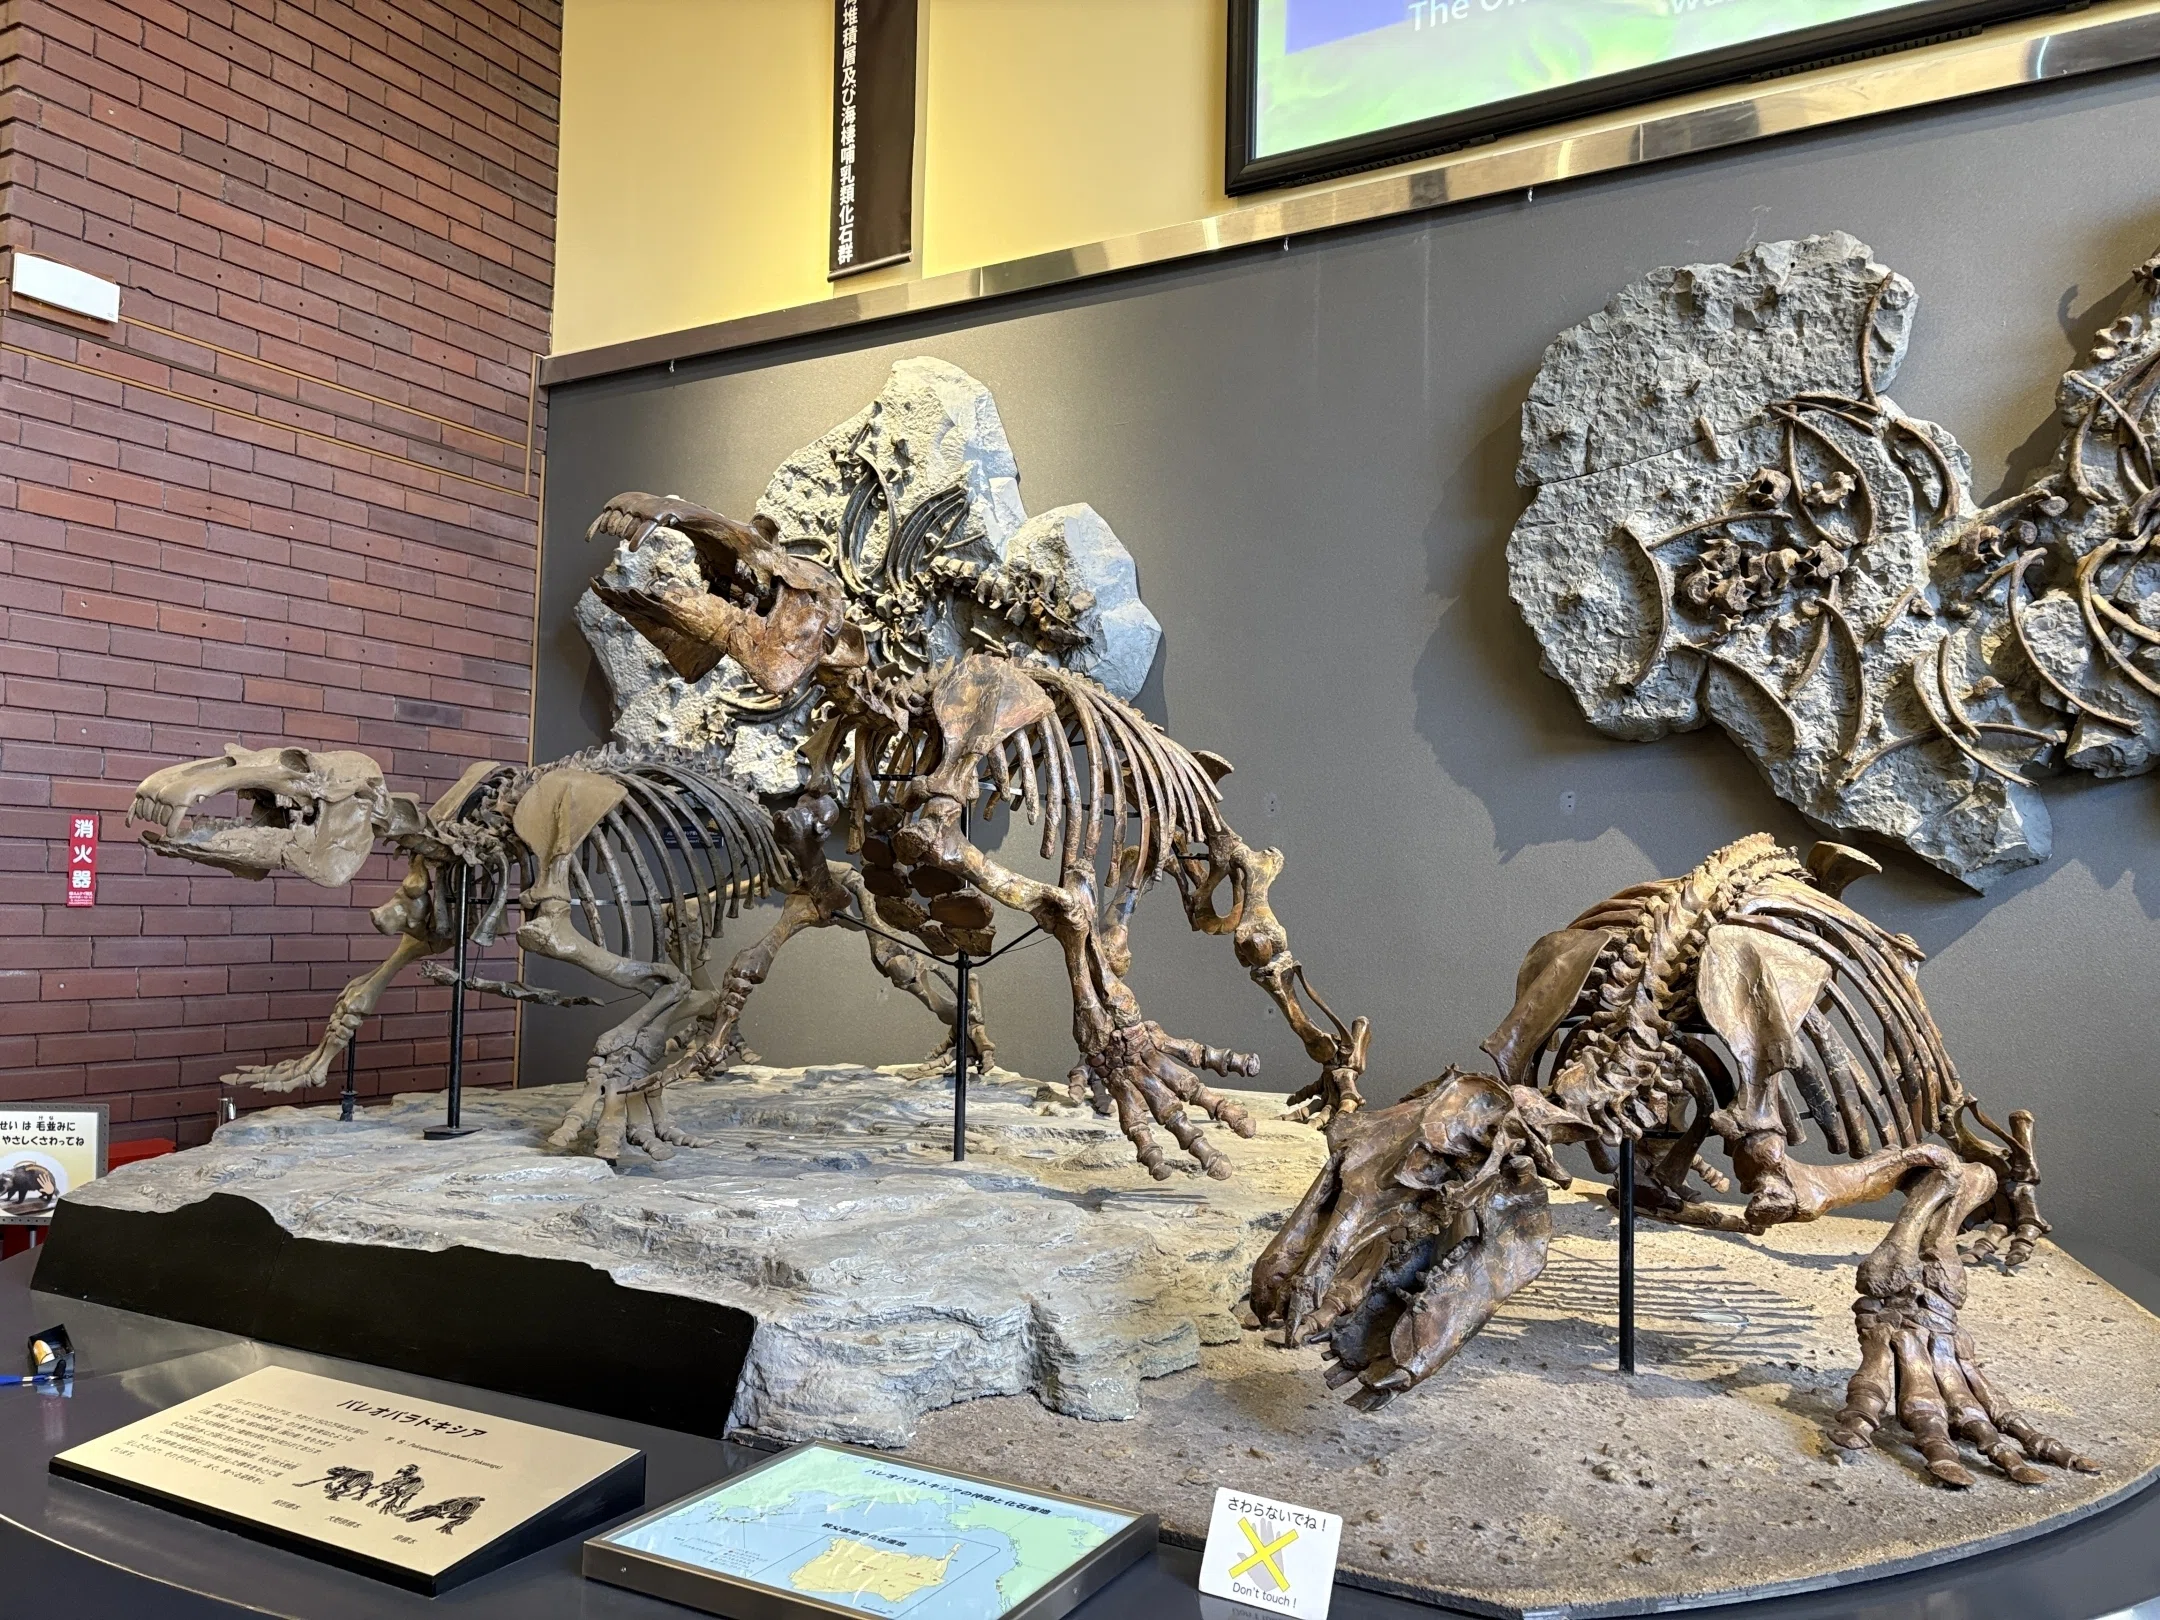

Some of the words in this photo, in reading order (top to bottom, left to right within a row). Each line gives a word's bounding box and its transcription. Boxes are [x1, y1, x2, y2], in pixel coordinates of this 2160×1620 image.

[1408, 0, 1470, 31] The
[73, 819, 94, 888] 消火器
[2, 1136, 84, 1146] やさしくさわってね
[336, 1400, 487, 1438] パレオパラドキシア
[865, 1469, 1051, 1515] パレオパラドキシアの仲間と化石産地
[1232, 1582, 1259, 1599] Don't
[1262, 1590, 1290, 1606] touch
